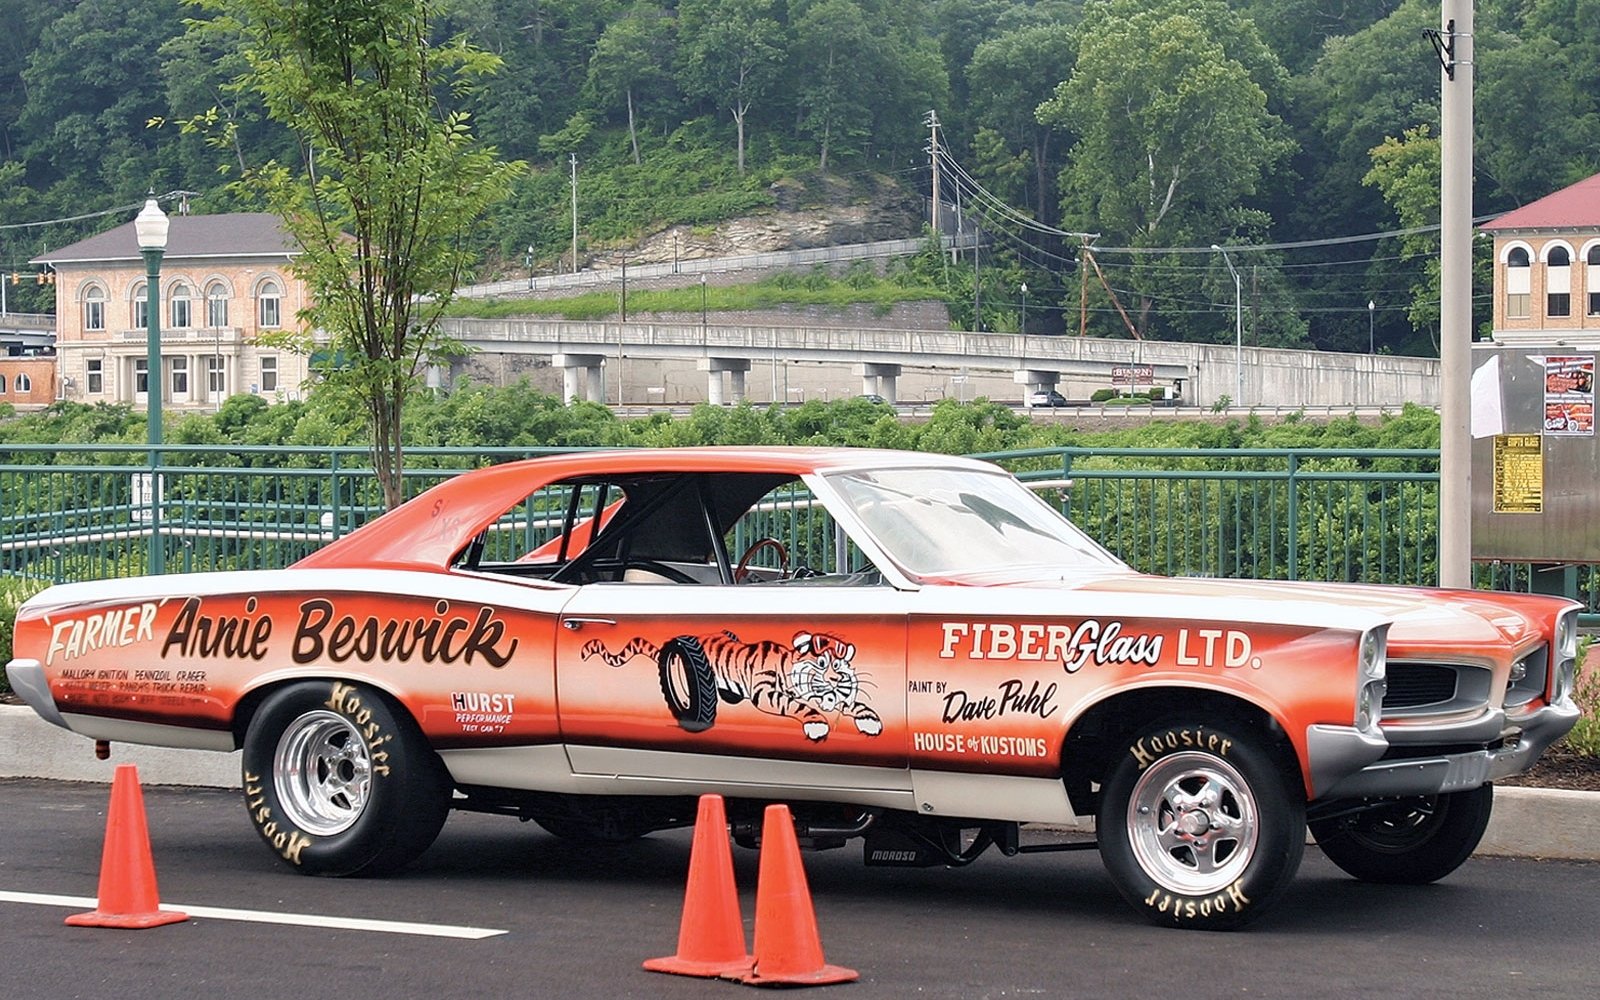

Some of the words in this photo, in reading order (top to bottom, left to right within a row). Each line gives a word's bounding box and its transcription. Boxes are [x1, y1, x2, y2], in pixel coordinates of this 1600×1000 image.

[160, 596, 273, 660] Arnie
[291, 597, 519, 669] Beswick
[1176, 628, 1262, 670] LTD.
[62, 669, 95, 681] MALLORY
[98, 669, 129, 681] IGNITION
[134, 670, 171, 682] PENNZOIL
[152, 682, 176, 693] TRUCK
[179, 683, 207, 694] REPAIR
[908, 680, 933, 693] PAINT
[936, 681, 947, 694] BY
[451, 691, 515, 714] HURST
[942, 690, 996, 724] Dave
[998, 679, 1058, 719] Puhl
[324, 681, 393, 777] Hoosier
[455, 713, 512, 724] PERFORMANCE
[462, 724, 479, 732] TEST
[480, 725, 494, 733] CAR
[914, 732, 966, 753] HOUSE
[967, 736, 980, 752] of
[980, 736, 1047, 757] KUSTOMS
[1129, 725, 1233, 770] Hoosier
[245, 771, 313, 865] Hoosier
[871, 850, 917, 861] MOROSO
[1144, 878, 1251, 921] Hoosier
